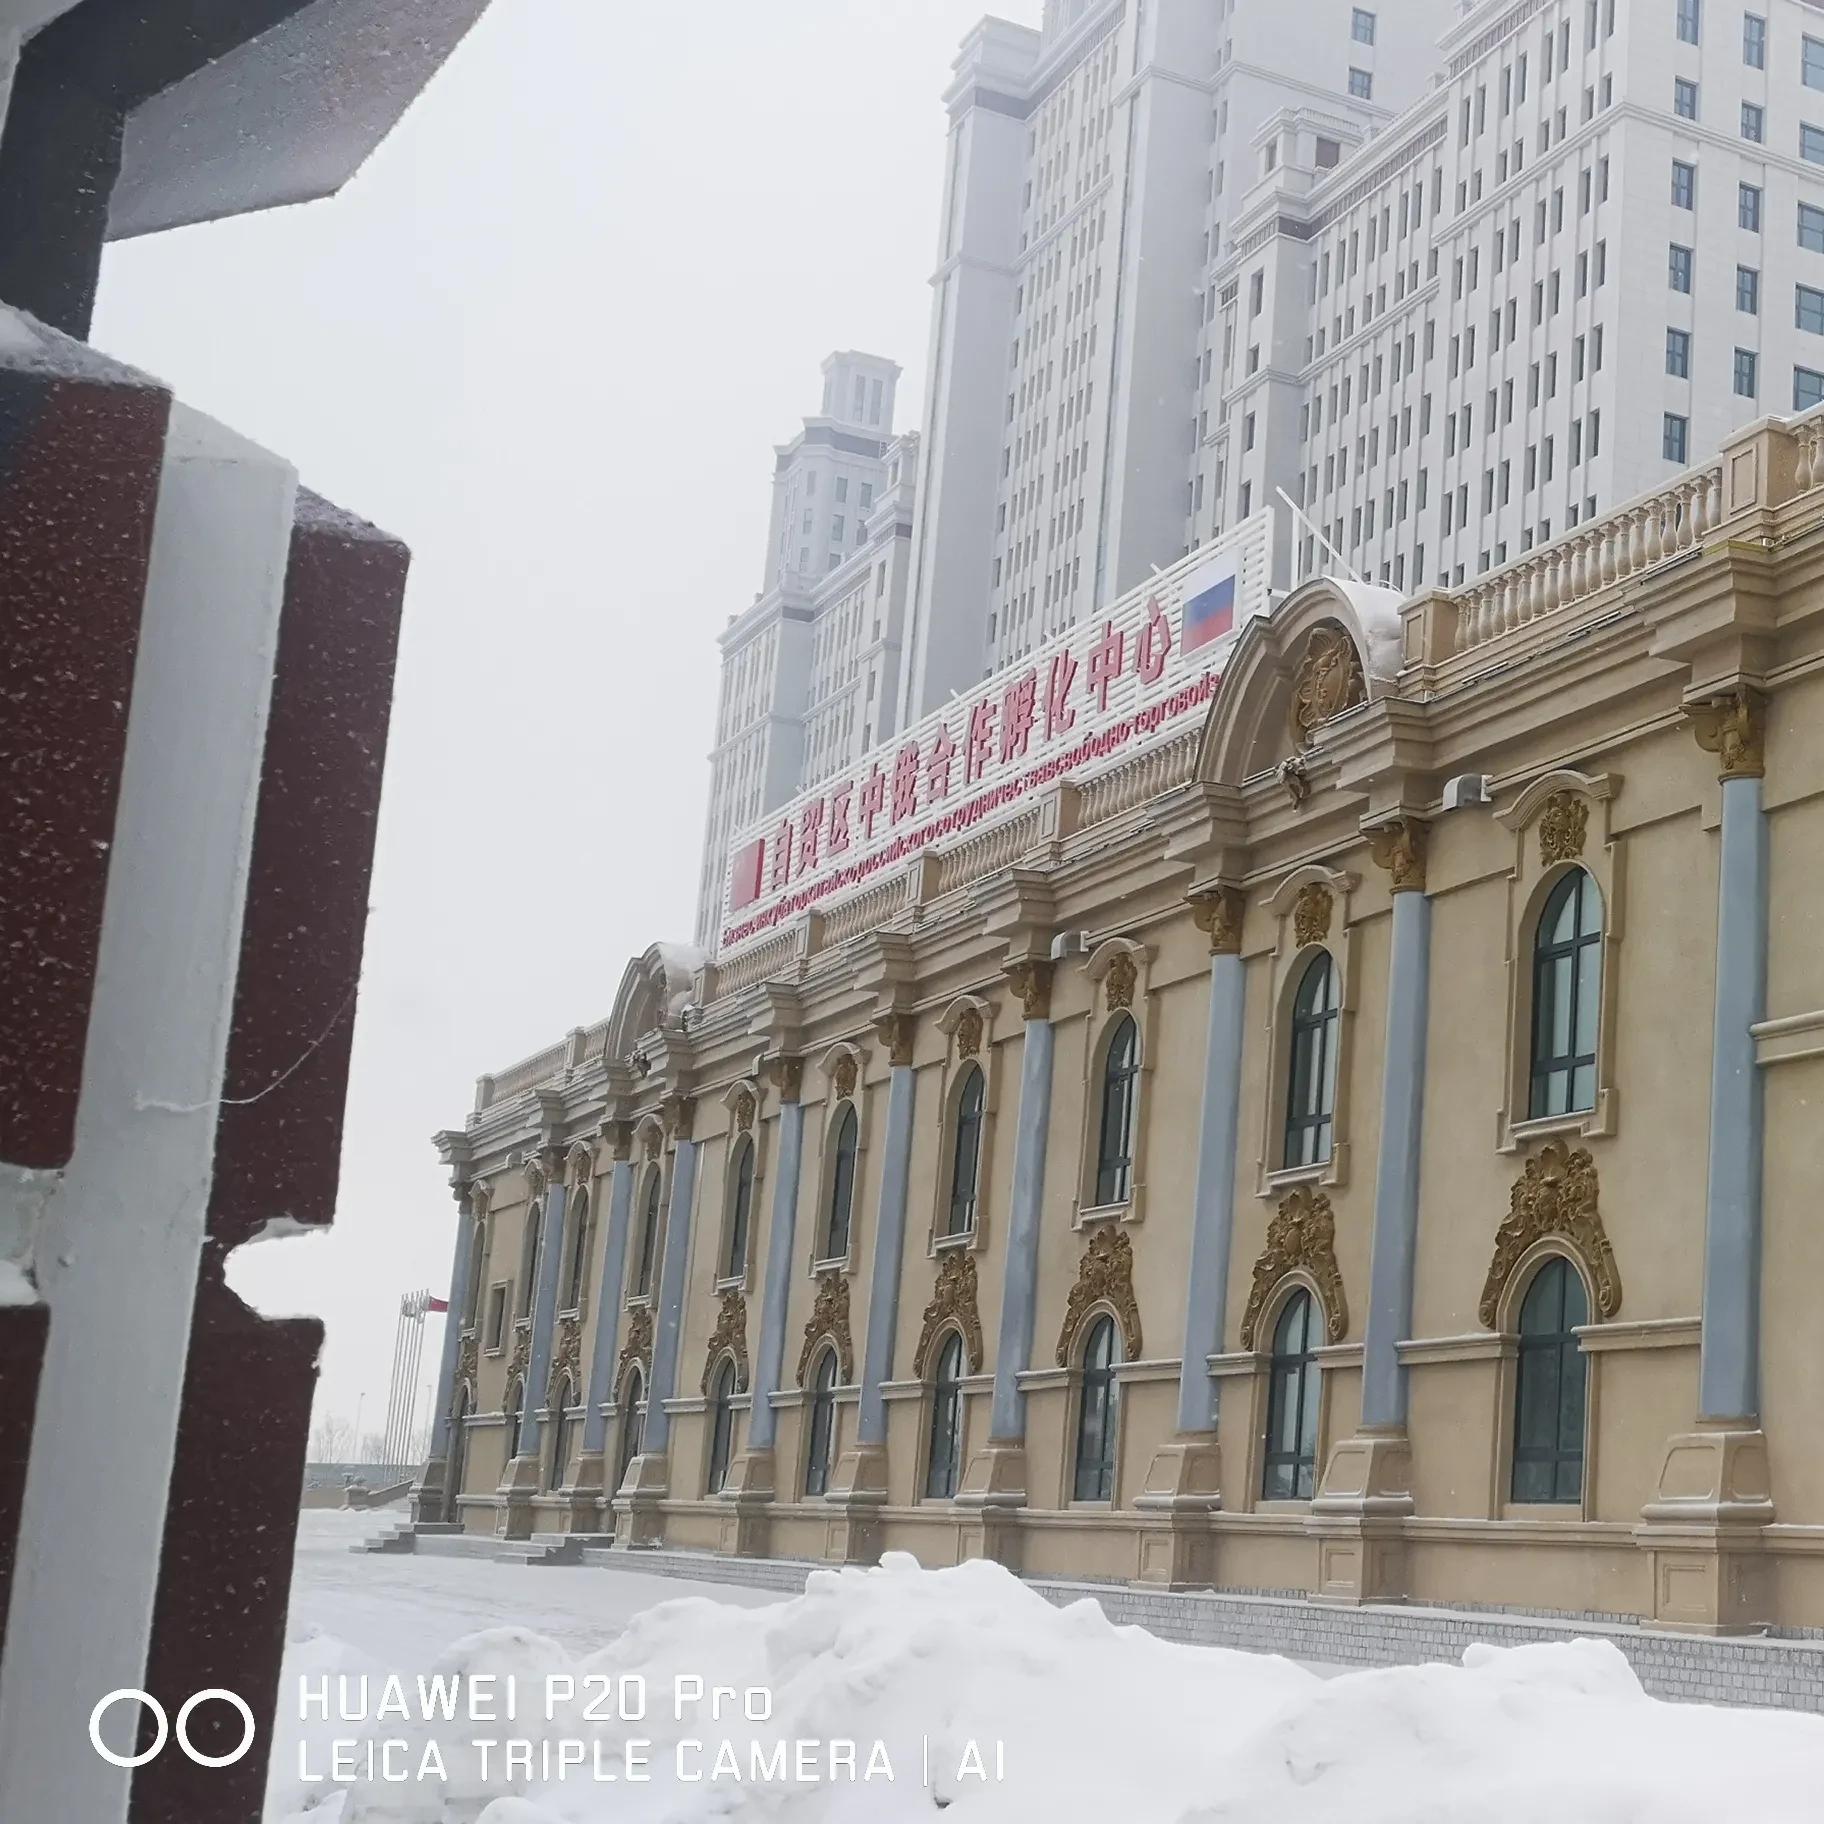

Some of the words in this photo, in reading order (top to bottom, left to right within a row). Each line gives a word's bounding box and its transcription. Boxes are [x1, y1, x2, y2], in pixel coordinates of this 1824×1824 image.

[770, 594, 1173, 891] 自贸区中俄合作孵化中心
